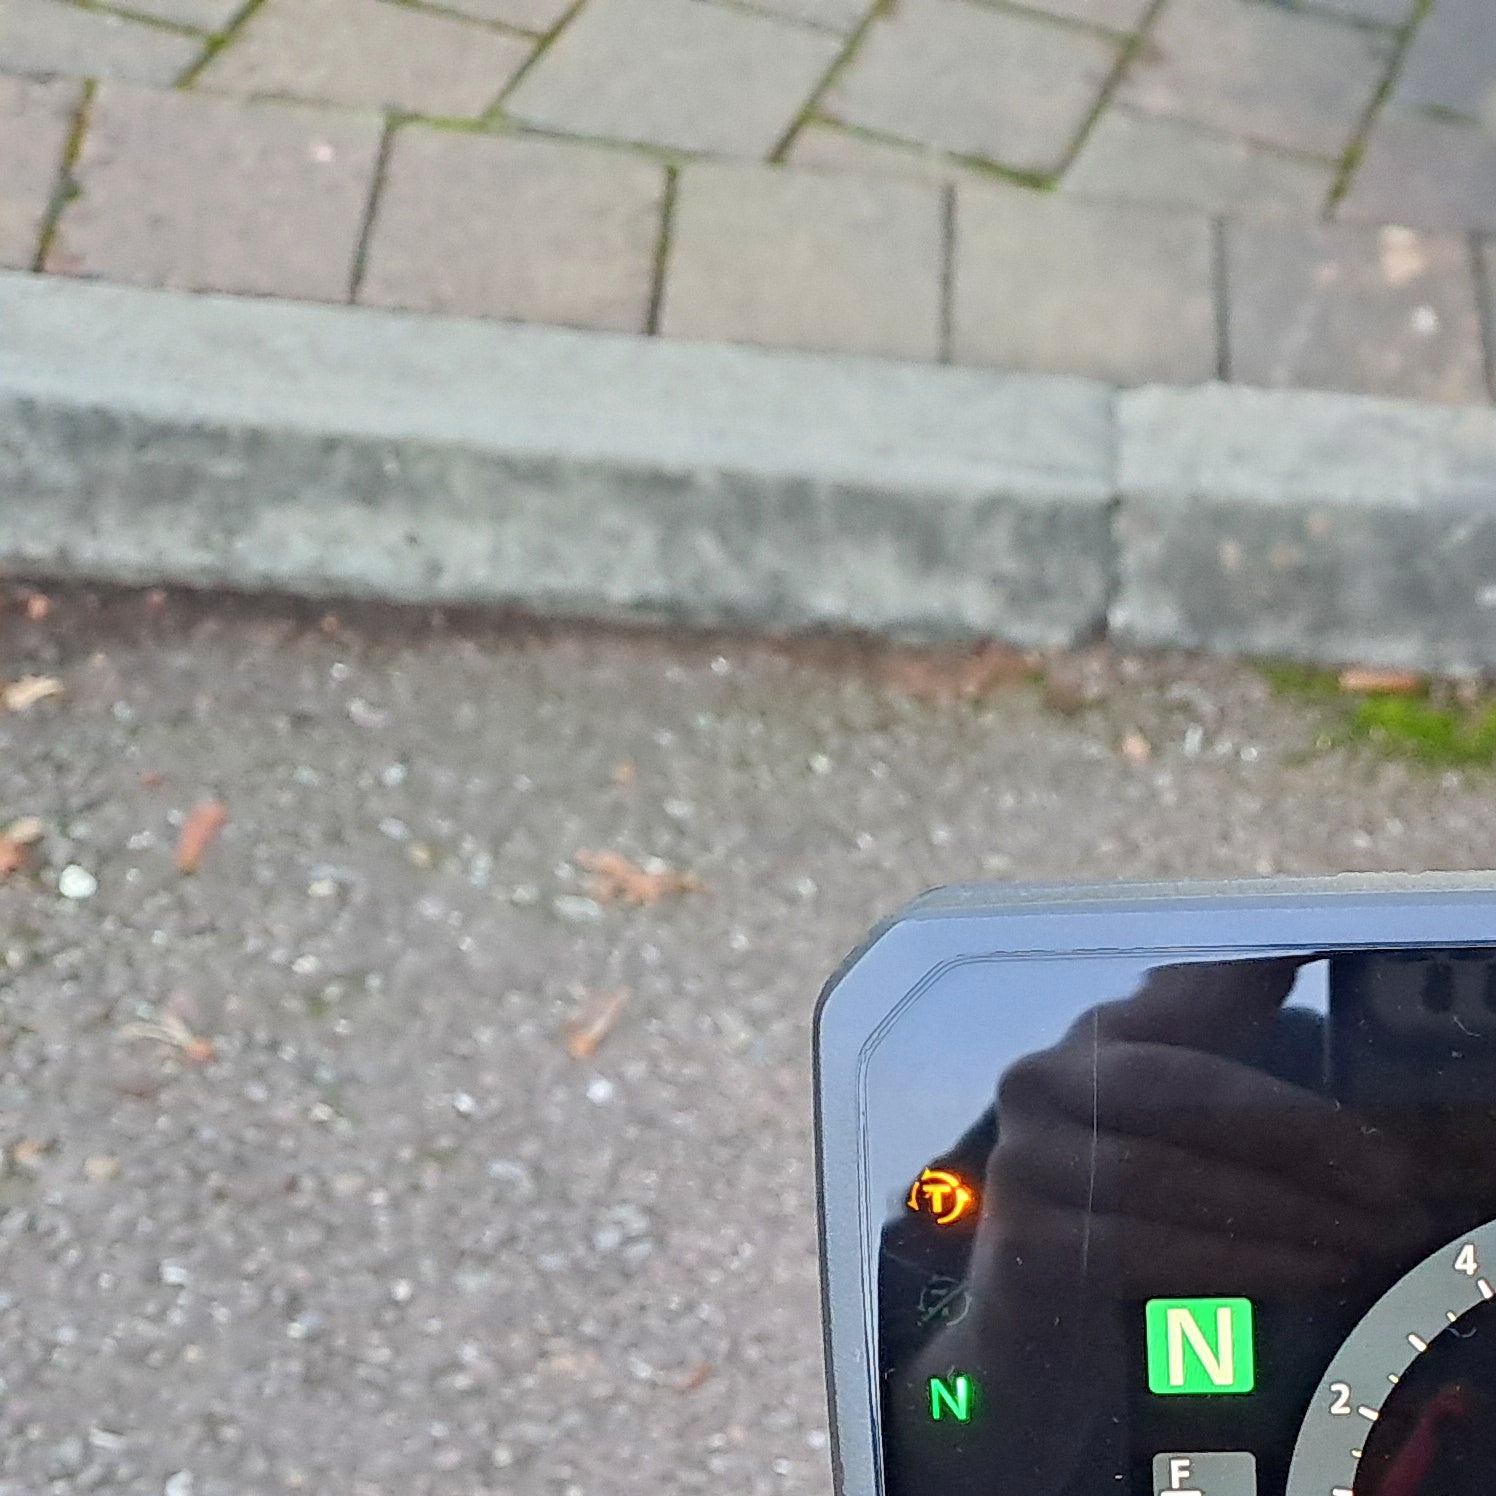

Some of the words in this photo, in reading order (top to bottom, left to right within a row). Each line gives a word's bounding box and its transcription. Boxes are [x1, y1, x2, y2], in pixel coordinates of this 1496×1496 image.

[1454, 1244, 1478, 1276] 4
[1166, 1307, 1234, 1387] N
[930, 1375, 970, 1421] N
[1330, 1383, 1352, 1415] 2
[1170, 1458, 1191, 1489] F
